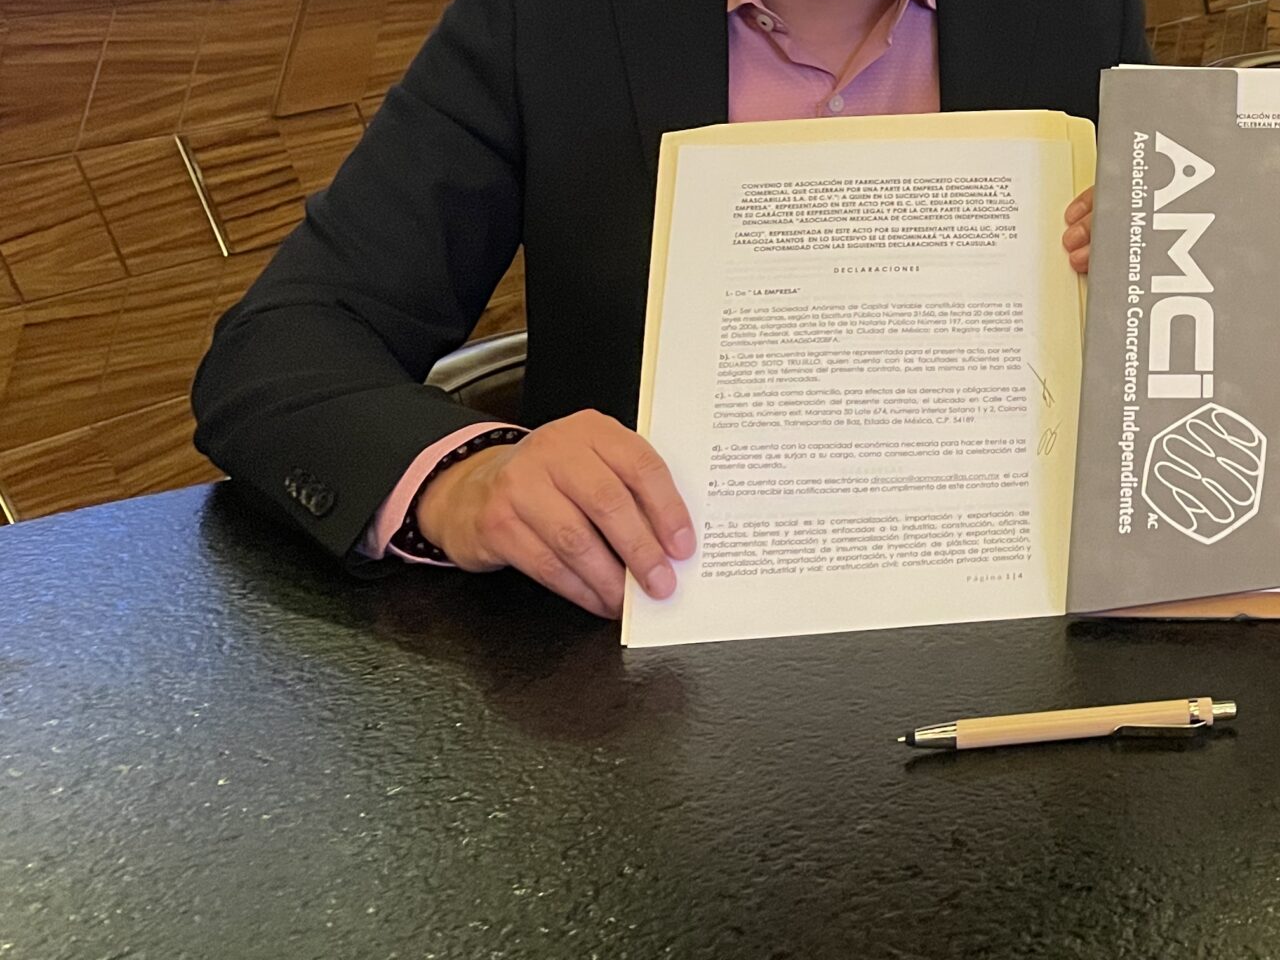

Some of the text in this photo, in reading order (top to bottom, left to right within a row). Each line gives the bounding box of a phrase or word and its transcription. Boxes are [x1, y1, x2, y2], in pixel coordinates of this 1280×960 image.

[741, 182, 782, 190] CONVENIO
[741, 196, 791, 204] MASCARILLAS
[950, 190, 998, 198] DENOMINARÁ
[775, 202, 828, 210] REPRESENTADO
[755, 209, 794, 218] CARÁCTER
[742, 218, 794, 226] DENOMINADA
[769, 229, 822, 237] REPRESENTADA
[732, 238, 774, 246] ZARAGOZA
[887, 232, 937, 240] DENOMINARÁ
[754, 244, 811, 252] CONFORMIDAD
[1118, 131, 1149, 534] Asociación Mexicana de Concreteros Independientes
